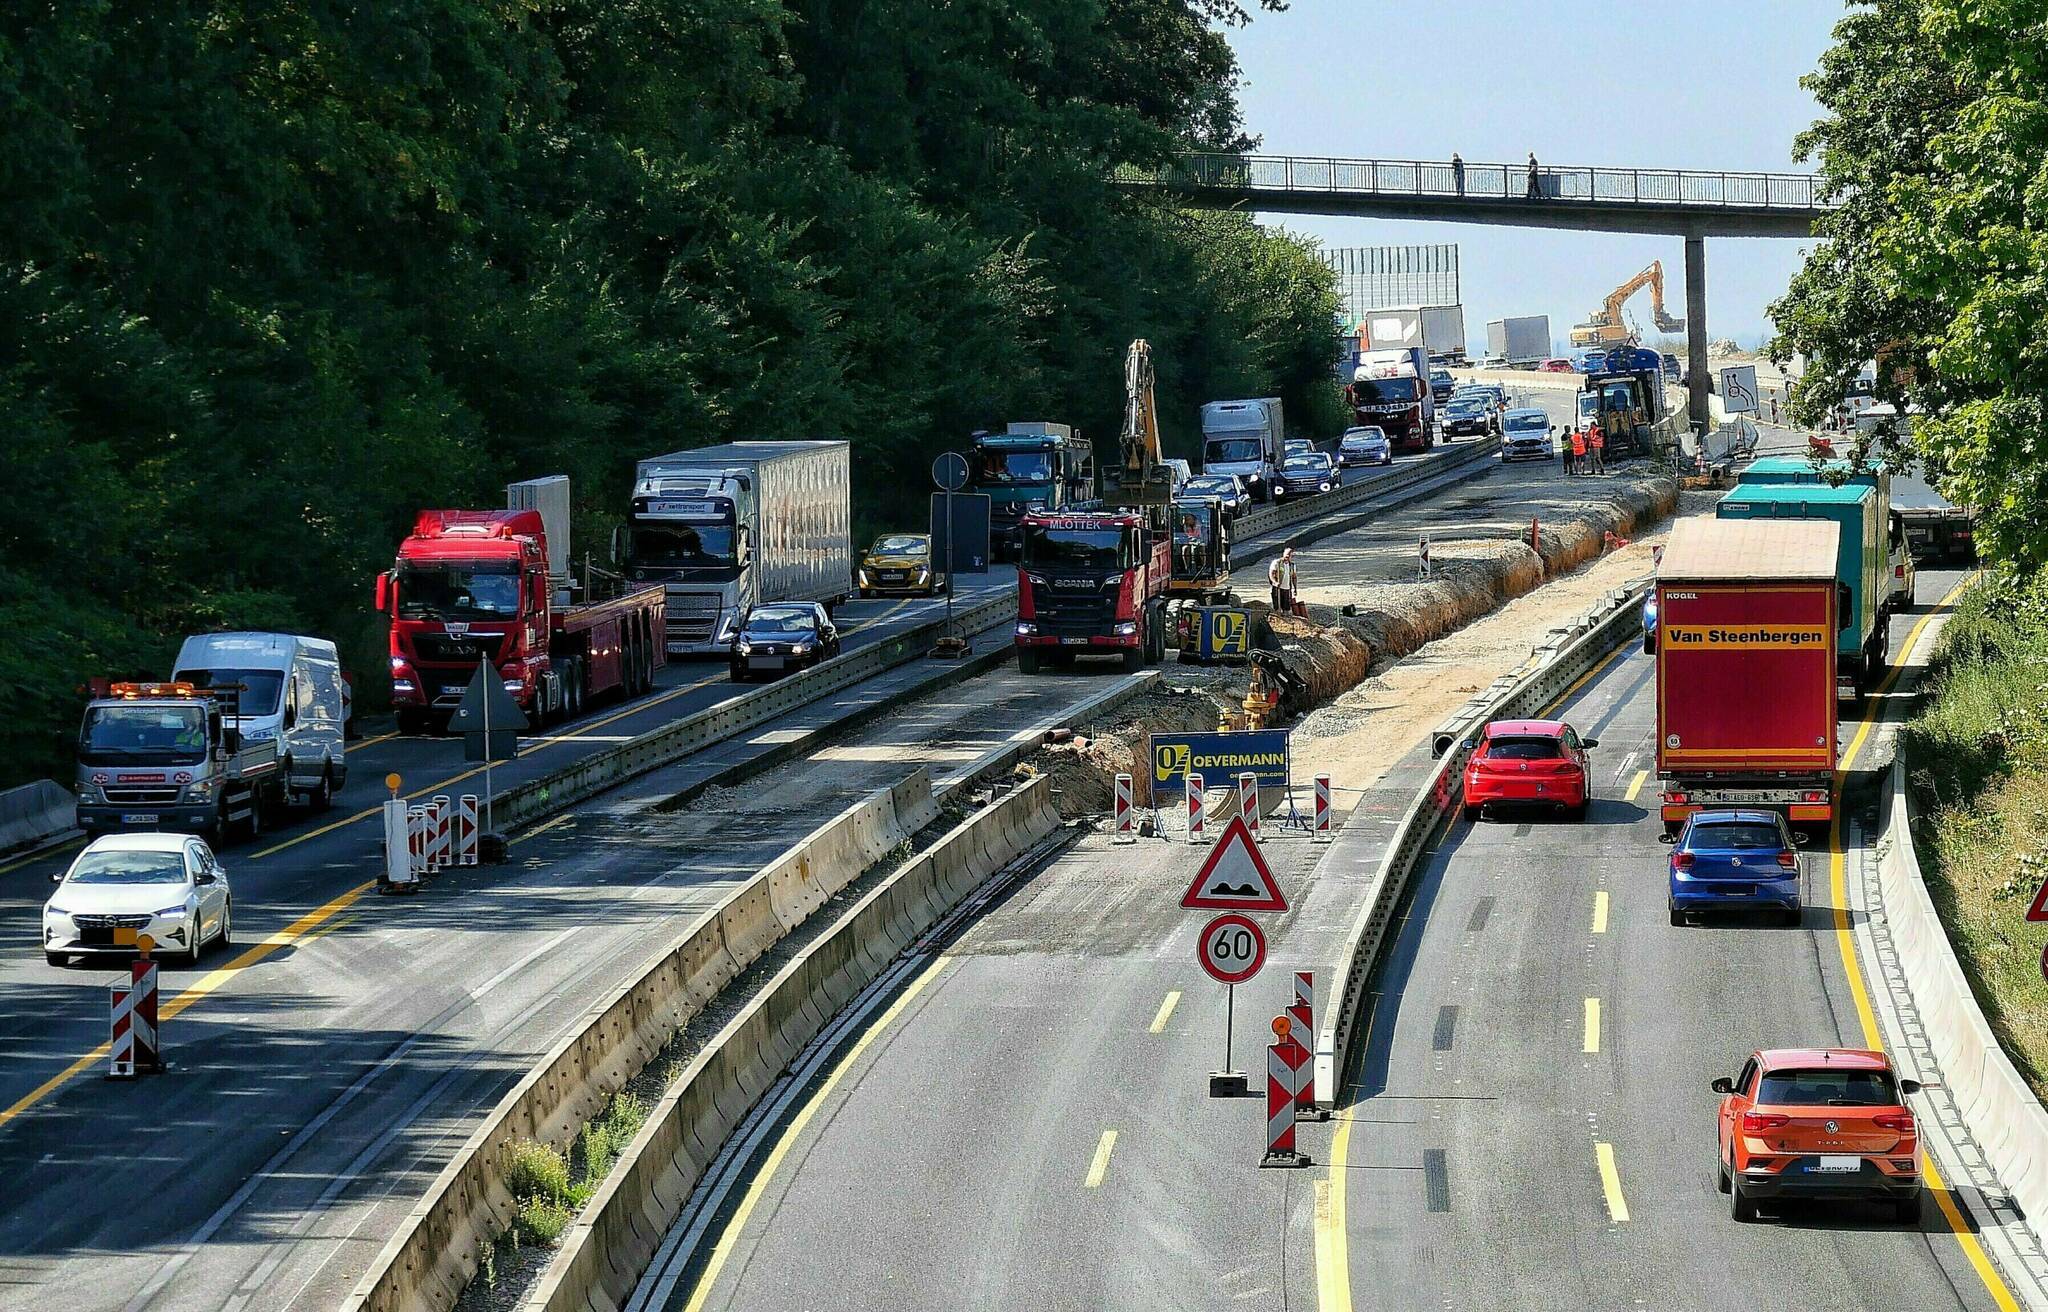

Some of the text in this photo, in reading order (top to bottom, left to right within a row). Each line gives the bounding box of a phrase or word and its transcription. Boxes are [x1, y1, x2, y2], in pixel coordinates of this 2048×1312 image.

[1049, 520, 1101, 530] MLOTTEK
[1054, 579, 1096, 588] SCANIA
[1669, 629, 1823, 645] Van Steenbergen
[1192, 752, 1285, 768] OEVERMANN
[1229, 771, 1285, 779] oeann.com
[1213, 929, 1252, 961] 60
